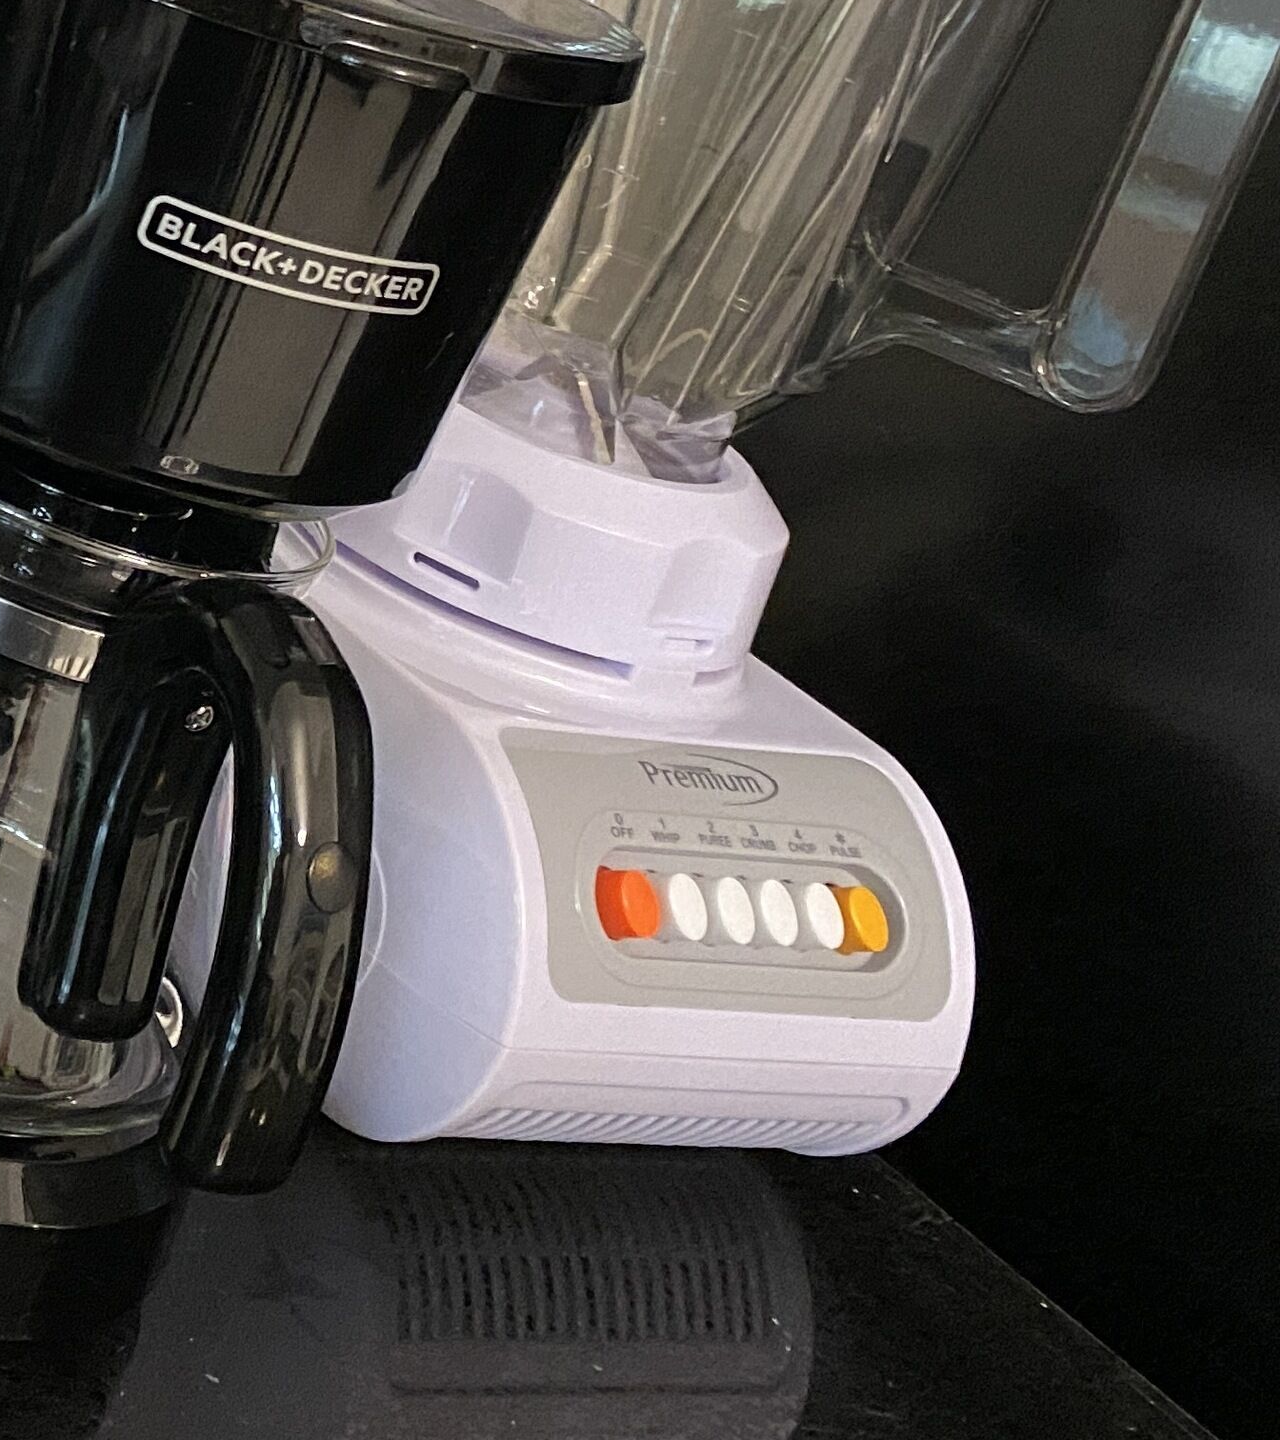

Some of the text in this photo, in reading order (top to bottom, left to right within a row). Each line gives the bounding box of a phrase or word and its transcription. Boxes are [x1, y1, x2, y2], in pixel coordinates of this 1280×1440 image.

[156, 213, 424, 301] BLACK+DECKER
[639, 760, 764, 795] Premium
[610, 825, 634, 839] OFF
